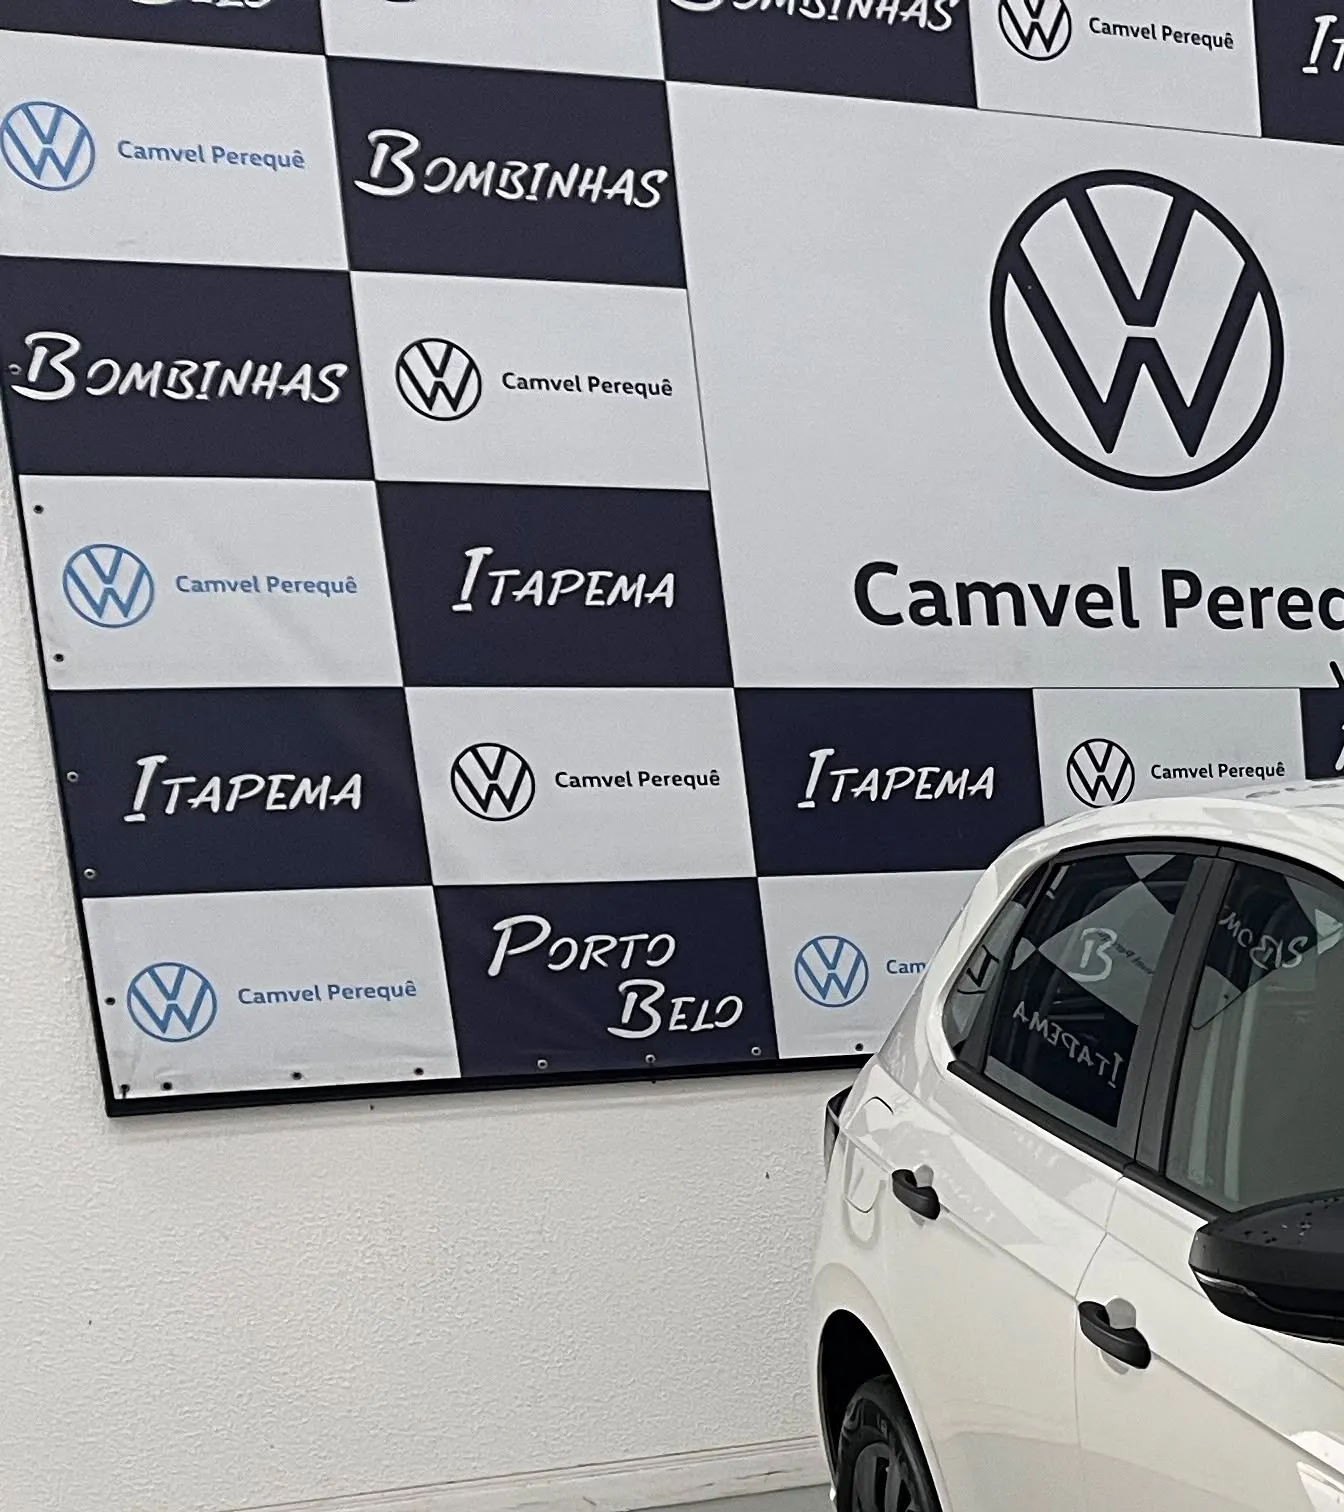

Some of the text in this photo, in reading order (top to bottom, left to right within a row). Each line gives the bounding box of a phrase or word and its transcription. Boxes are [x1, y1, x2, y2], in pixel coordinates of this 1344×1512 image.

[670, 0, 960, 32] BINHAS
[1088, 16, 1157, 41] Camvel
[1161, 24, 1234, 51] Perequê
[117, 139, 206, 164] Camvel
[211, 145, 305, 172] Perequê
[353, 128, 668, 208] BOMBINHAS
[9, 331, 348, 403] BOMBINHAS
[501, 371, 582, 393] Camvel
[587, 375, 673, 400] Perequê
[175, 575, 261, 594] Camvel
[266, 575, 358, 598] Perequê
[451, 546, 675, 612] ITAPEMA
[854, 561, 1140, 629] Camvel
[123, 754, 362, 822] ITAPEMA
[554, 770, 633, 789] Camvel
[637, 769, 721, 791] Perequê
[797, 748, 995, 809] ITAPEMA
[1150, 763, 1212, 780] Camvel
[1217, 761, 1285, 781] Perequê
[487, 914, 676, 977] PORTO
[886, 959, 926, 975] Cam
[238, 984, 322, 1005] Camvel
[327, 980, 417, 1002] Perequê
[607, 978, 743, 1039] BELO
